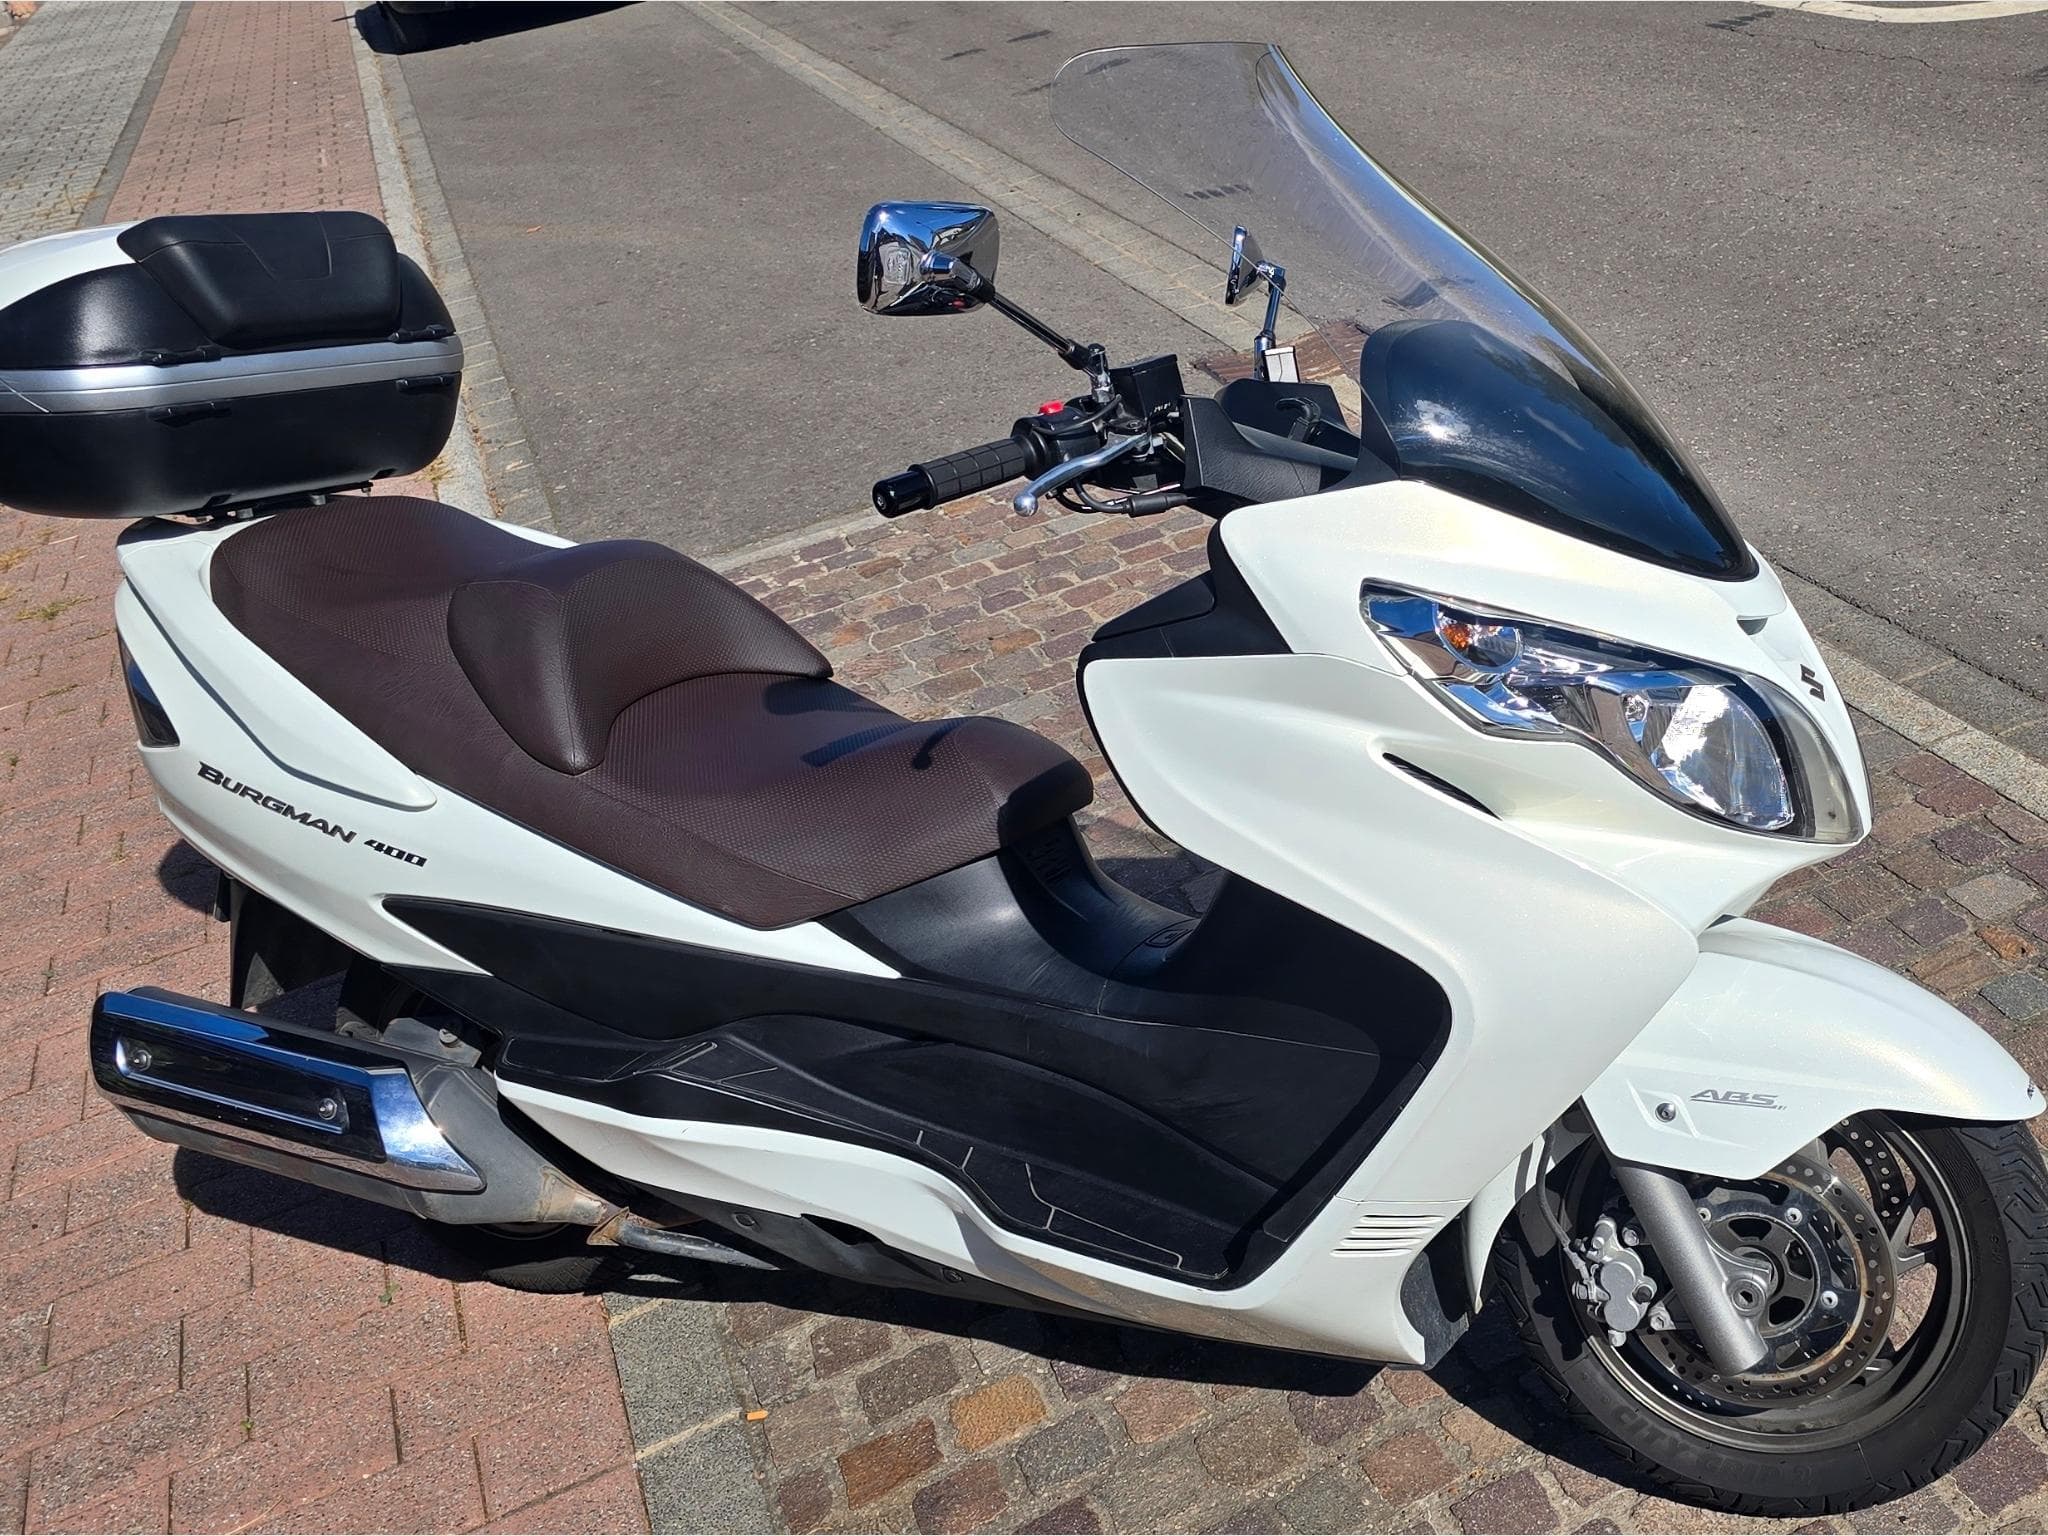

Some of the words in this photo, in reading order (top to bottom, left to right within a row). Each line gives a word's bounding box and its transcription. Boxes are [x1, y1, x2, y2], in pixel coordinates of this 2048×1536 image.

[198, 761, 357, 844] BURGMAN
[364, 839, 427, 867] 400
[1690, 1089, 1779, 1108] ABS
[1611, 1405, 1689, 1455] CITY
